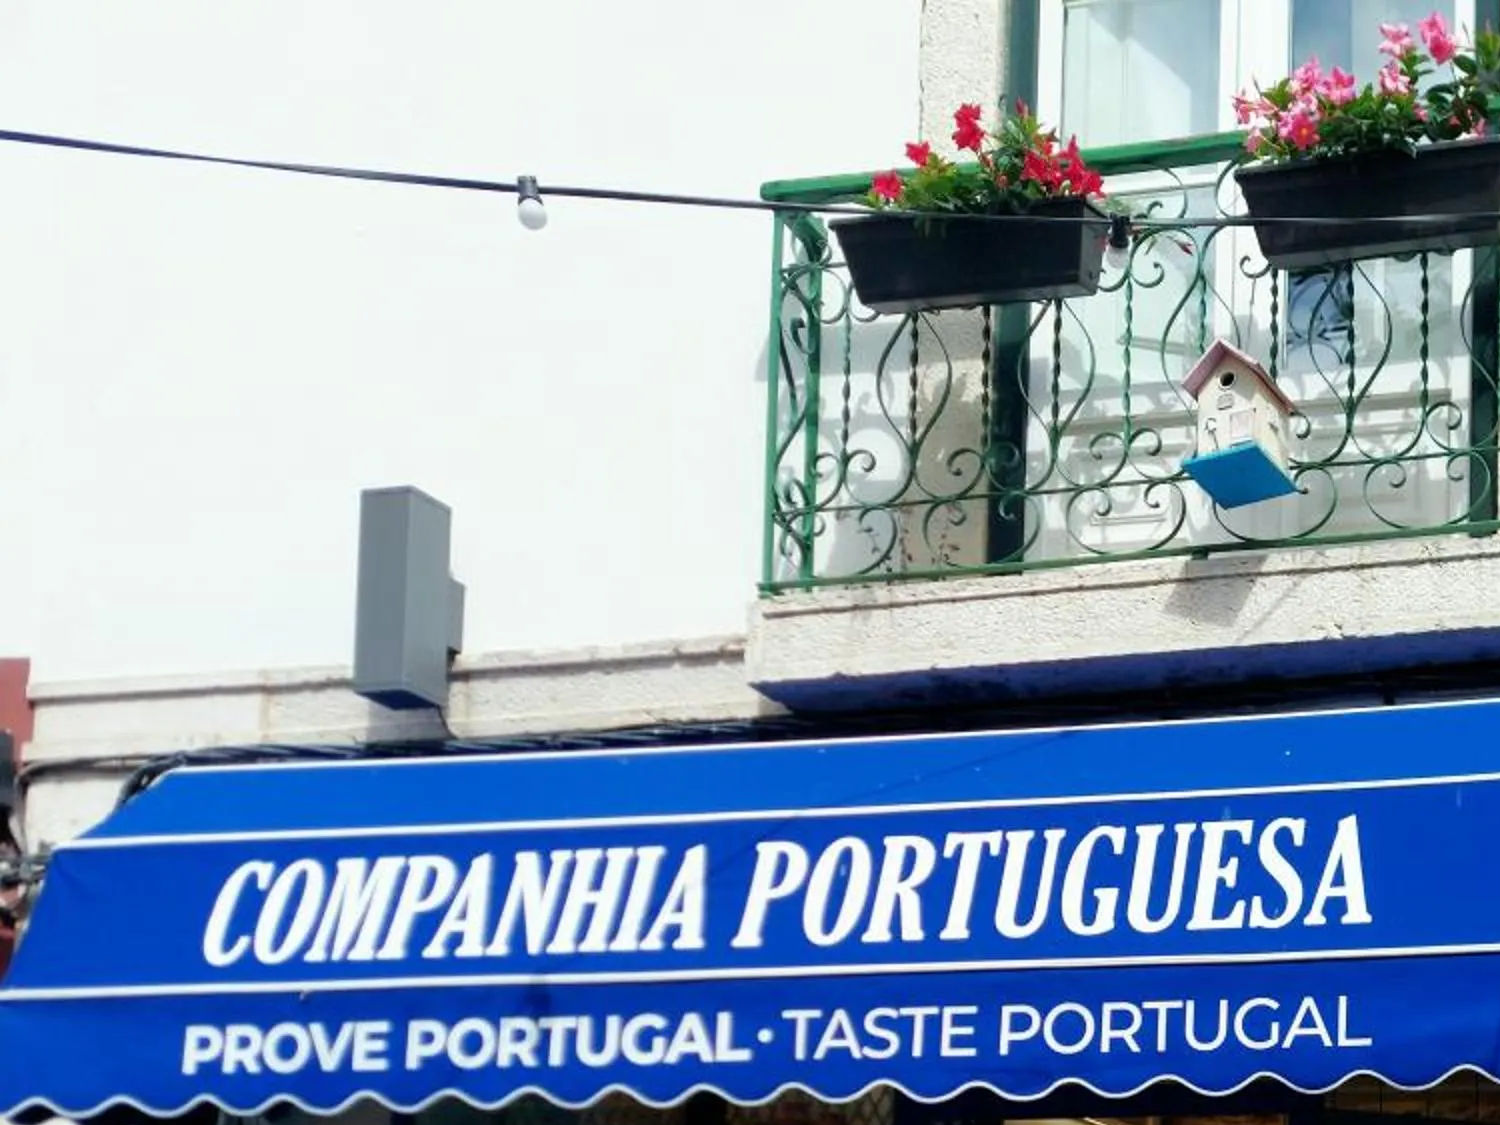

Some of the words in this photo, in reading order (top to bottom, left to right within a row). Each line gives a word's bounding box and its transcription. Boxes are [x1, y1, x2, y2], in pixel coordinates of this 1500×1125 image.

[203, 844, 707, 968] COMPANHIA
[730, 814, 1373, 948] PORTUGUESA
[181, 1020, 392, 1075] PROVE
[405, 1010, 753, 1070] PORTUGAL
[782, 1005, 979, 1061] TASTE
[999, 995, 1374, 1056] PORTUGAL
